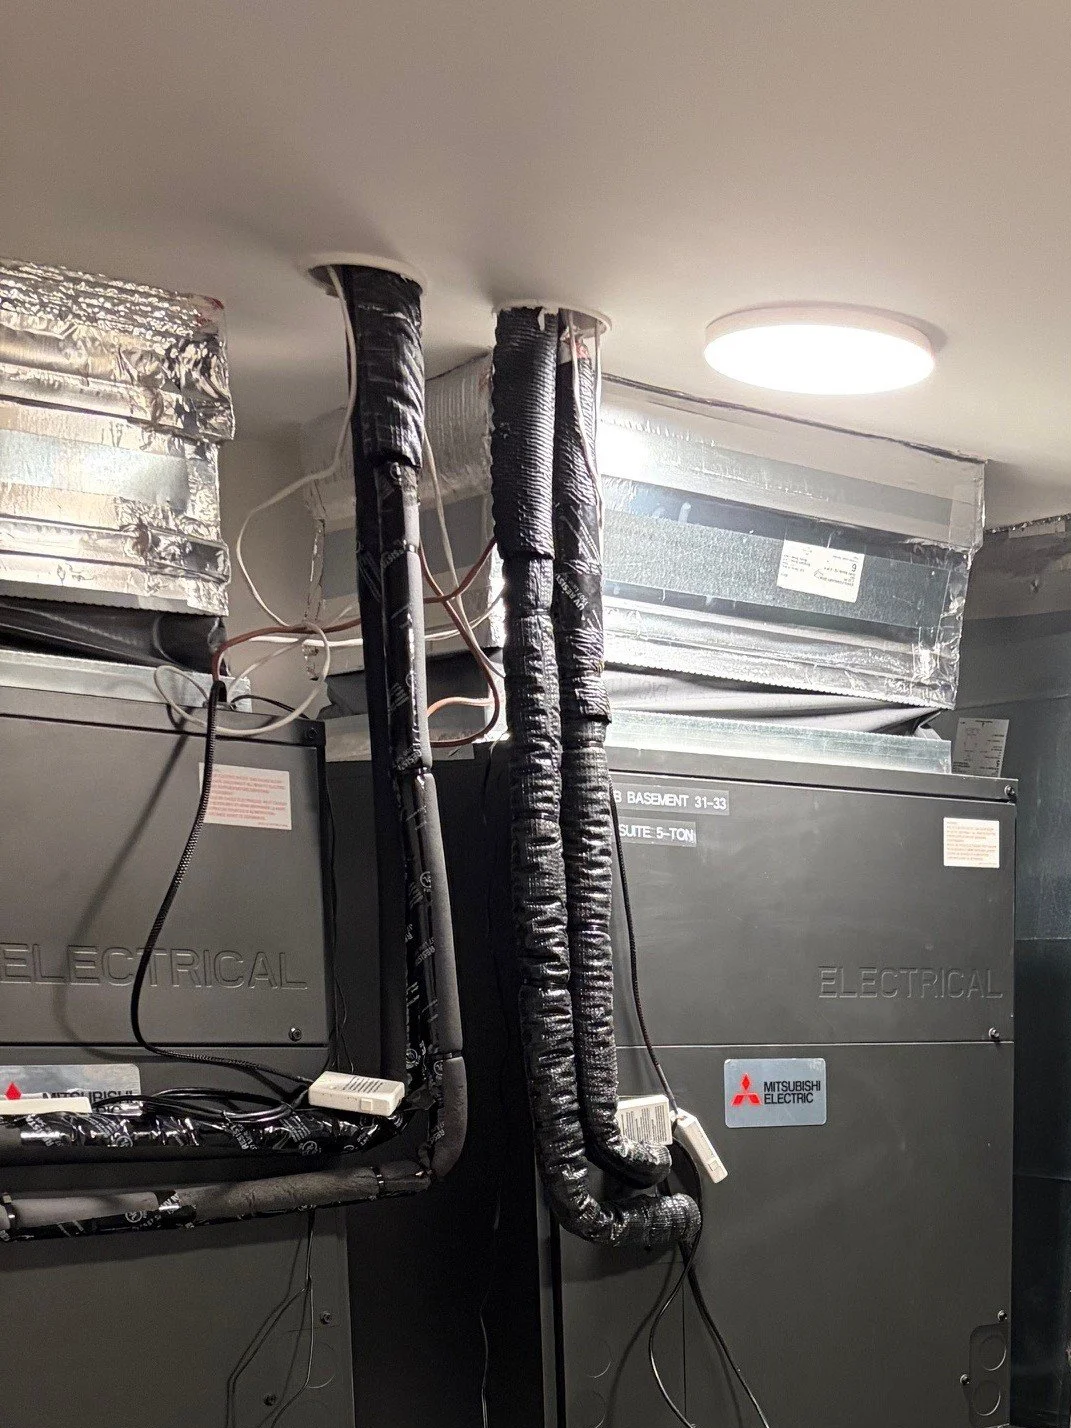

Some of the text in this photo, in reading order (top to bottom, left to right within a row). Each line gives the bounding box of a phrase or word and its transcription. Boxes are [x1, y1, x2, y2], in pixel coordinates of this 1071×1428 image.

[627, 791, 690, 807] BASEMENT
[694, 796, 727, 810] 31-33
[619, 823, 694, 842] SUITE 5-TON
[0, 942, 308, 990] ELECTRICAL
[818, 965, 1004, 999] ELECTRICAL
[764, 1080, 822, 1092] MITSUBISHI
[764, 1092, 814, 1105] ELECTRIC
